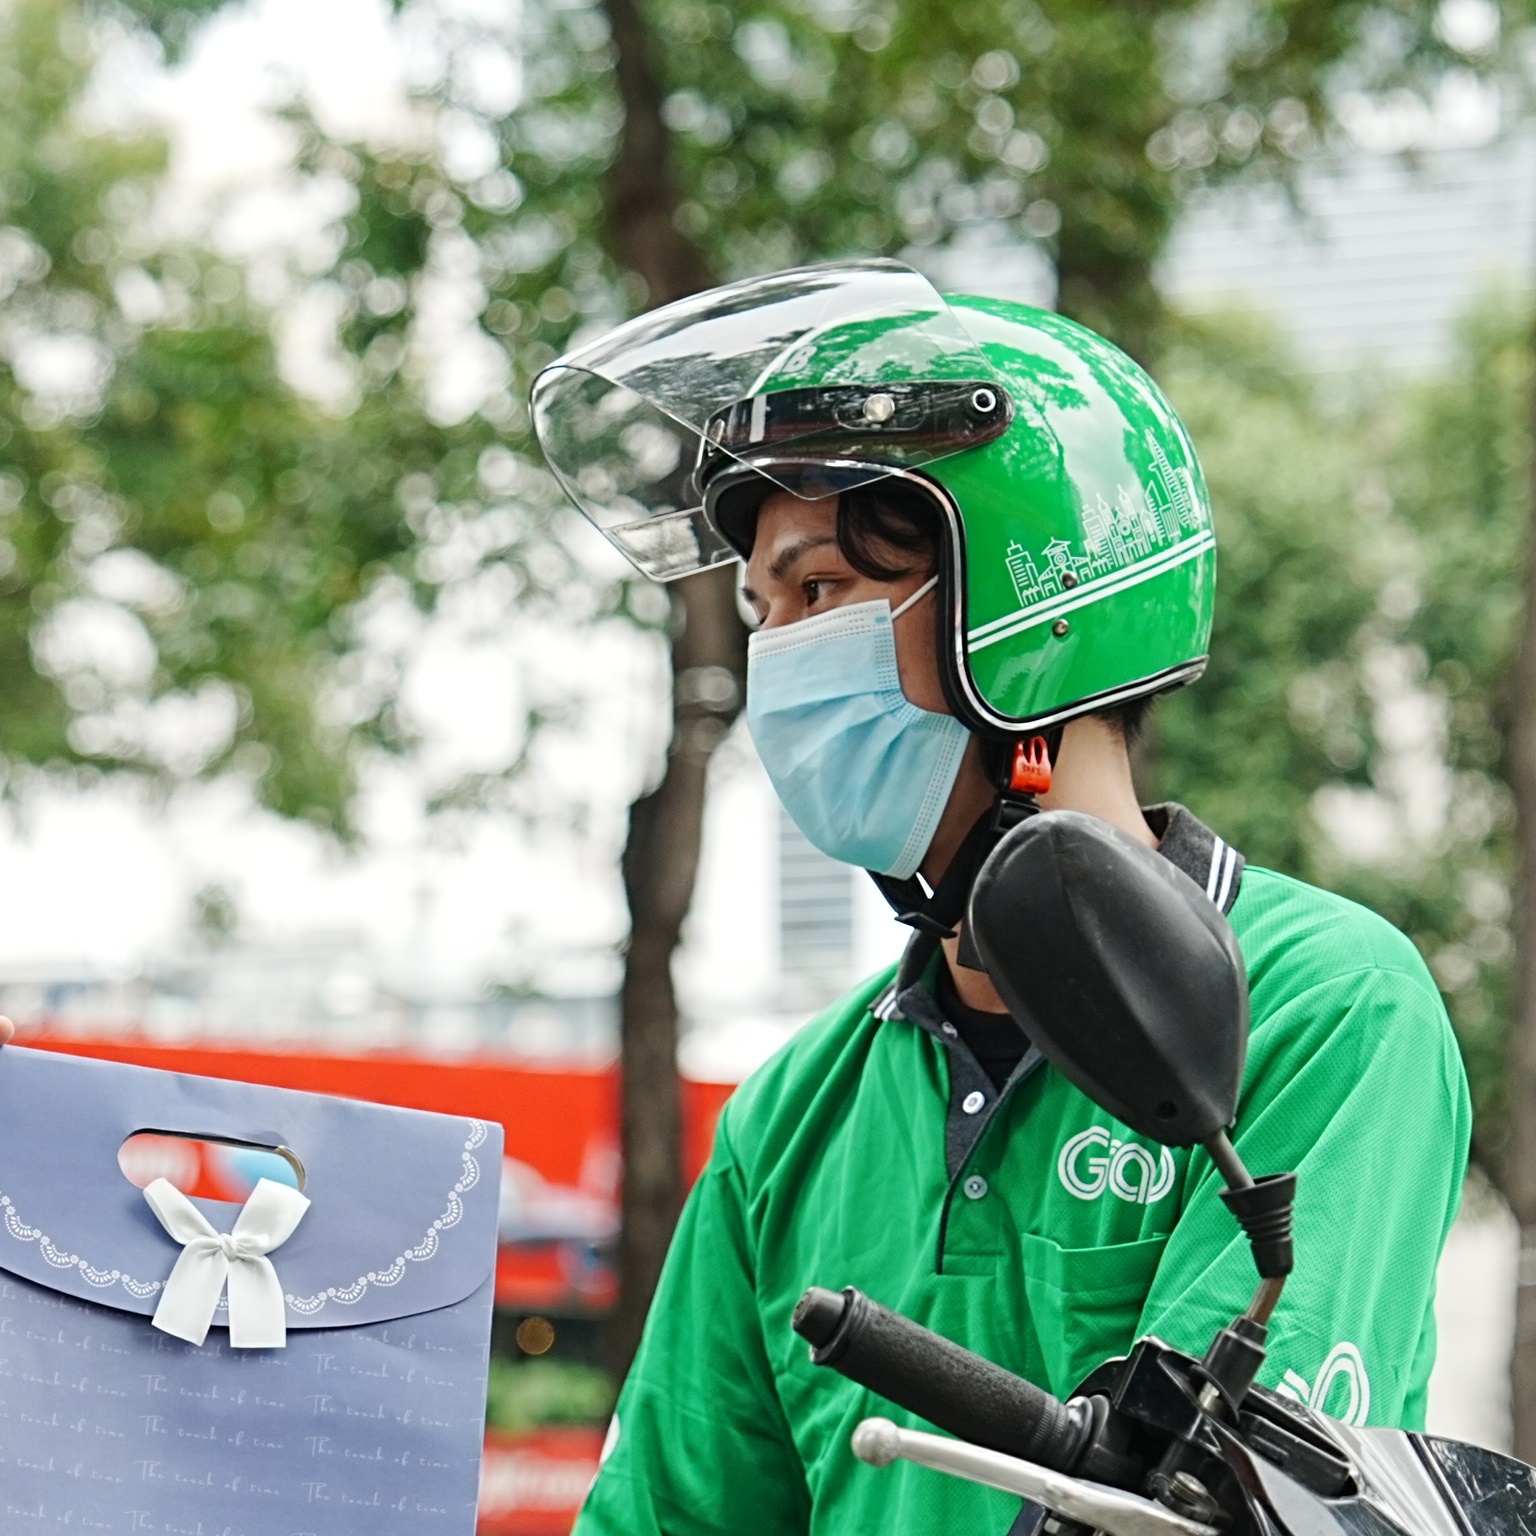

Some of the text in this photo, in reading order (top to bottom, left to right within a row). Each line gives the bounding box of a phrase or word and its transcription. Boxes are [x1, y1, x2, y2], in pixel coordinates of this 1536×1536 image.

[309, 1353, 339, 1374] The
[140, 1374, 170, 1395] The
[305, 1394, 336, 1415] The
[138, 1415, 167, 1436] The
[304, 1436, 335, 1457] The
[134, 1460, 164, 1481] The
[301, 1482, 330, 1503] The
[124, 1510, 153, 1531] The
